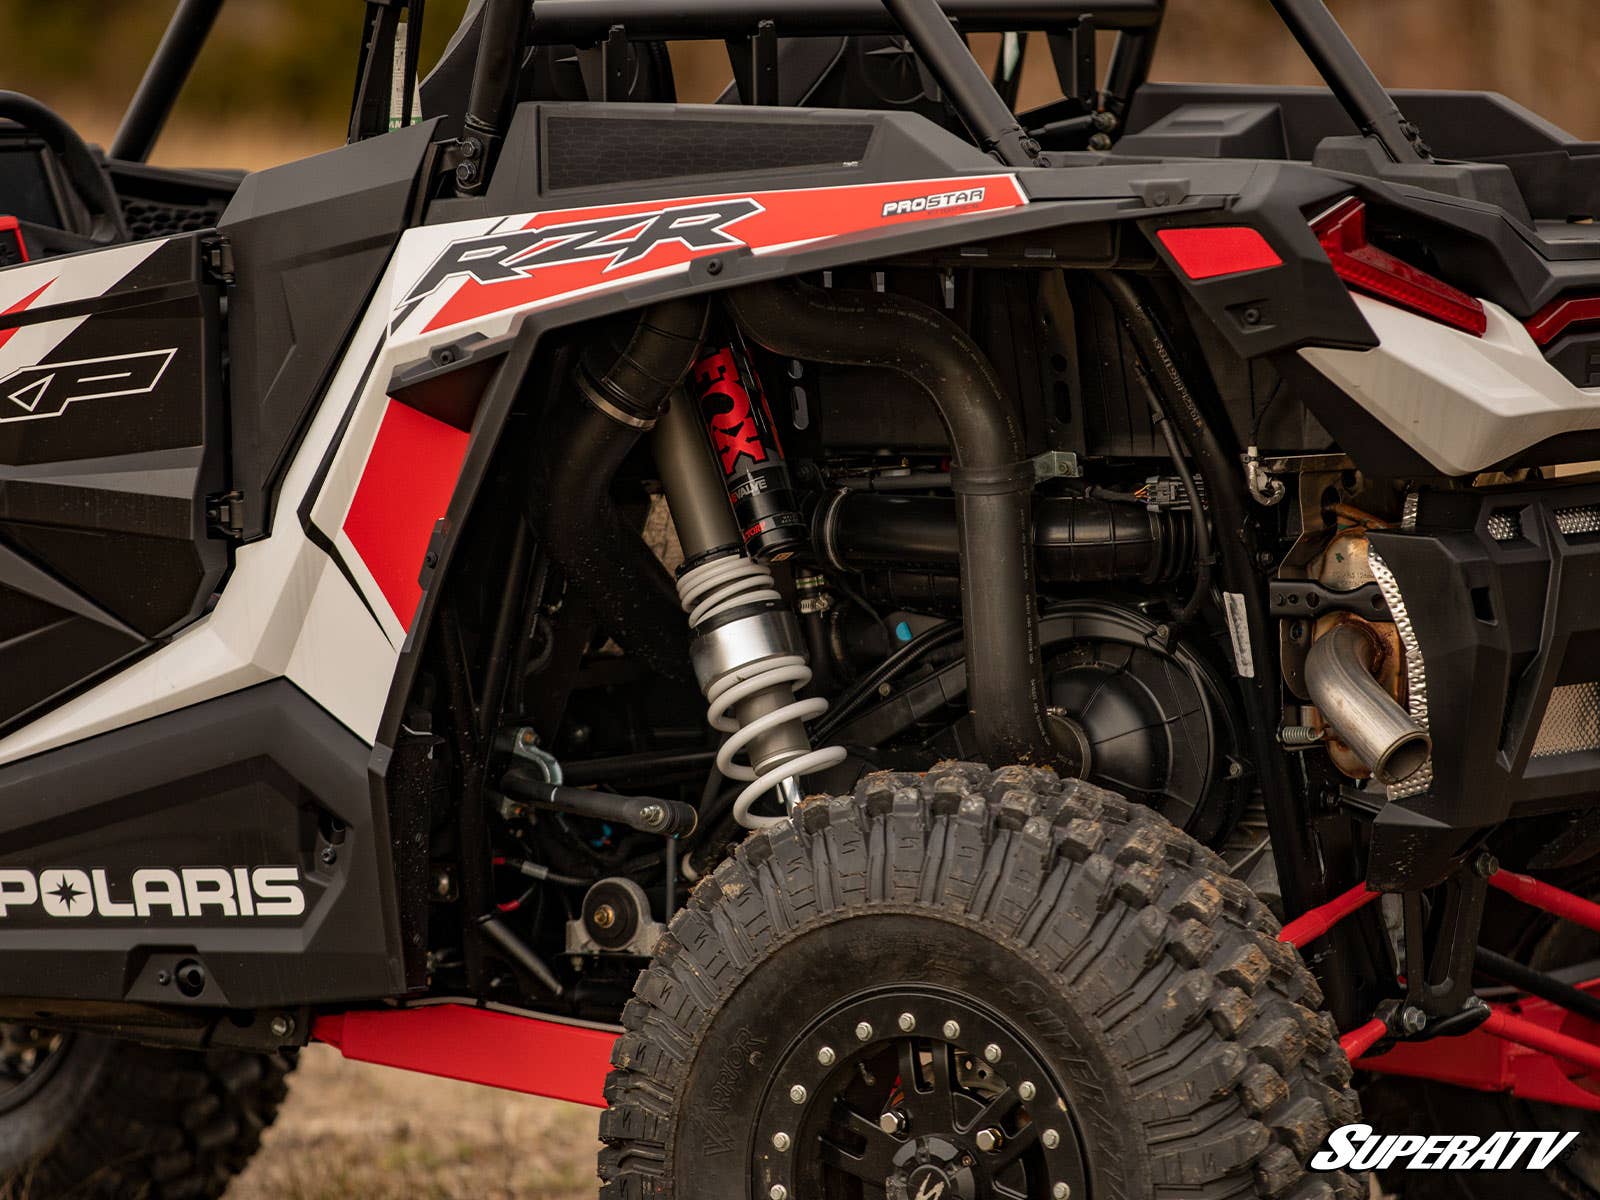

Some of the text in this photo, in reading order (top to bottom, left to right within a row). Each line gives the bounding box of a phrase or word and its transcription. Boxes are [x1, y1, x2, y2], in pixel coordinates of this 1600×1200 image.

[881, 187, 986, 216] PROSTAR
[394, 197, 764, 312] RZR
[693, 345, 768, 476] FOX
[0, 867, 305, 918] POLARIS
